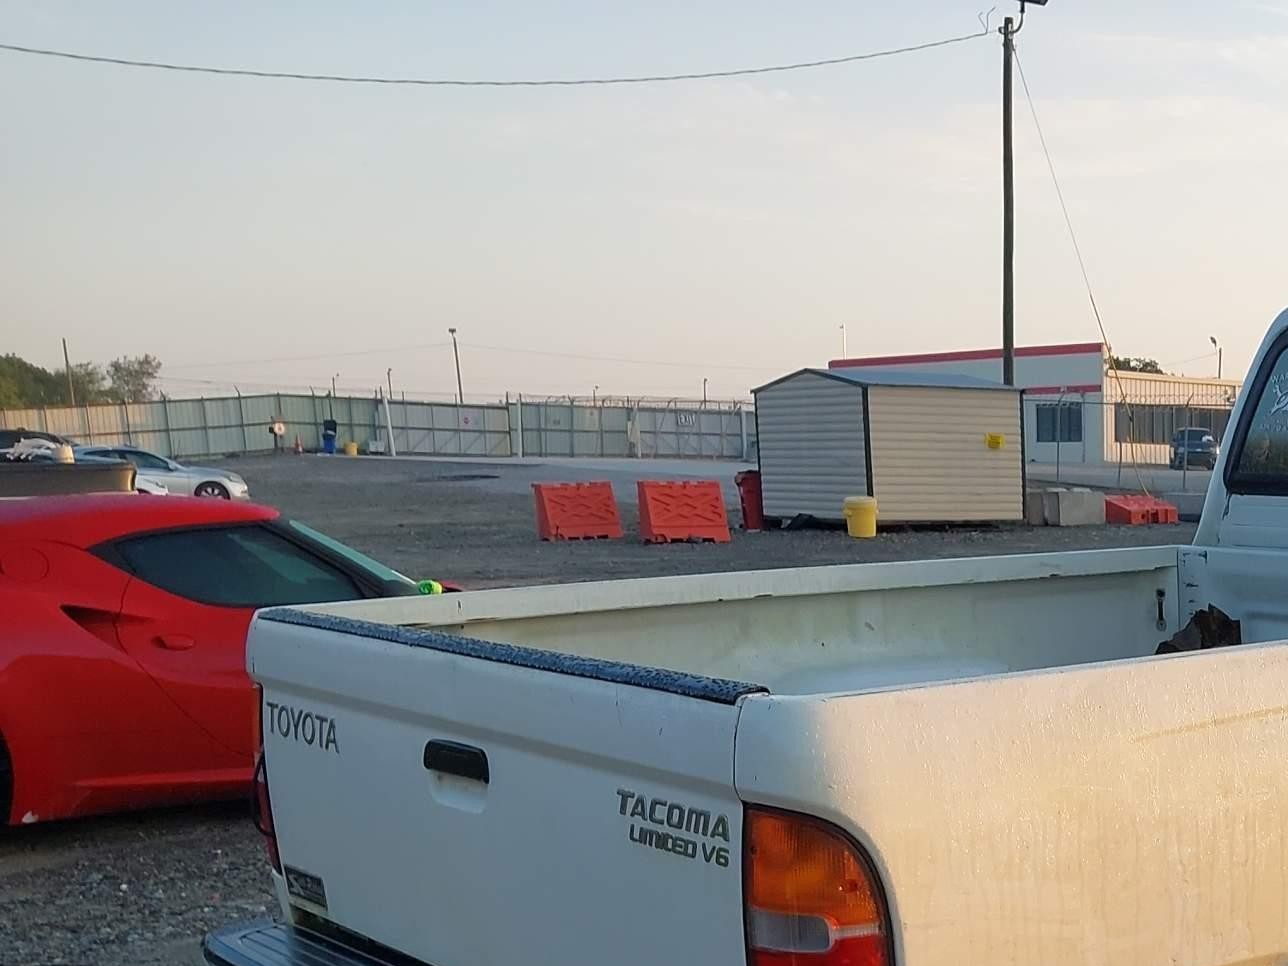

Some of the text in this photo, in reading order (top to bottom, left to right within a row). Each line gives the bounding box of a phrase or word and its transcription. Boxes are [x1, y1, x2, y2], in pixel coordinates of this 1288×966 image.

[266, 701, 340, 754] TOYOTA
[617, 788, 730, 842] TACOMA
[629, 823, 730, 868] LIMITED V6
